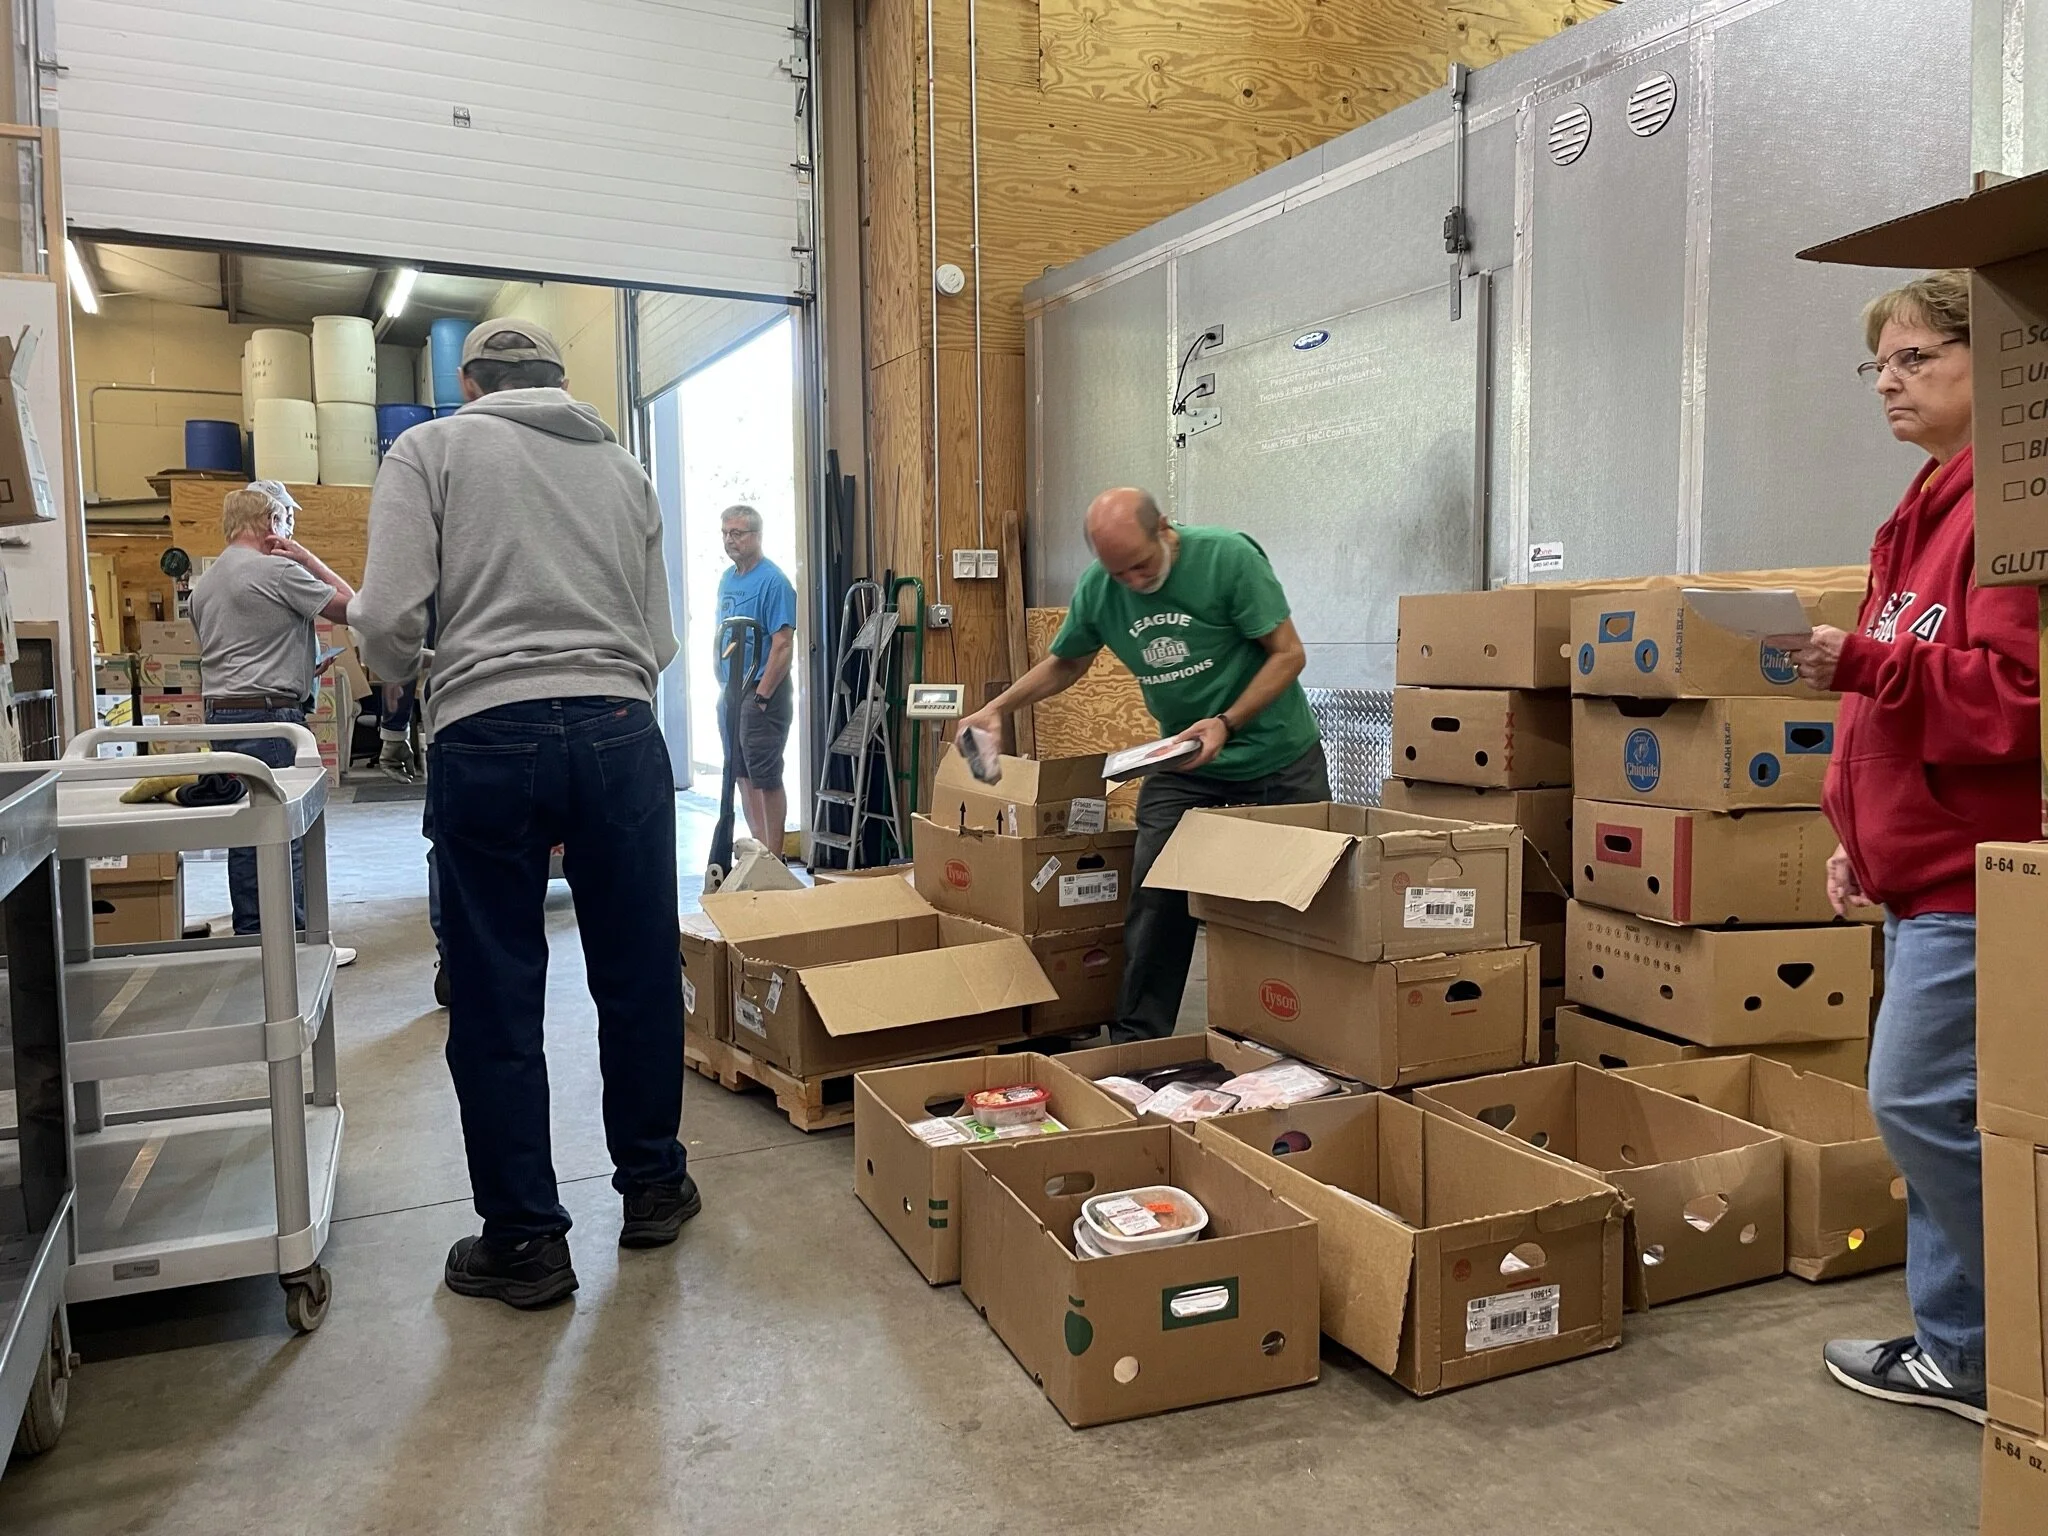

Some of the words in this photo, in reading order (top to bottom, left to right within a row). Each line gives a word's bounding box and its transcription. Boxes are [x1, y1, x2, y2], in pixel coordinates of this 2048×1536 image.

[1991, 550, 2048, 575] GLUT
[1129, 612, 1193, 638] LEAGUE
[1625, 761, 1659, 781] Chiquita
[1985, 856, 2014, 873] 8-64
[2022, 863, 2041, 876] oz.
[1265, 985, 1297, 1010] Tyson
[1994, 1436, 2021, 1460] 8-64
[2029, 1455, 2047, 1473] oz.
